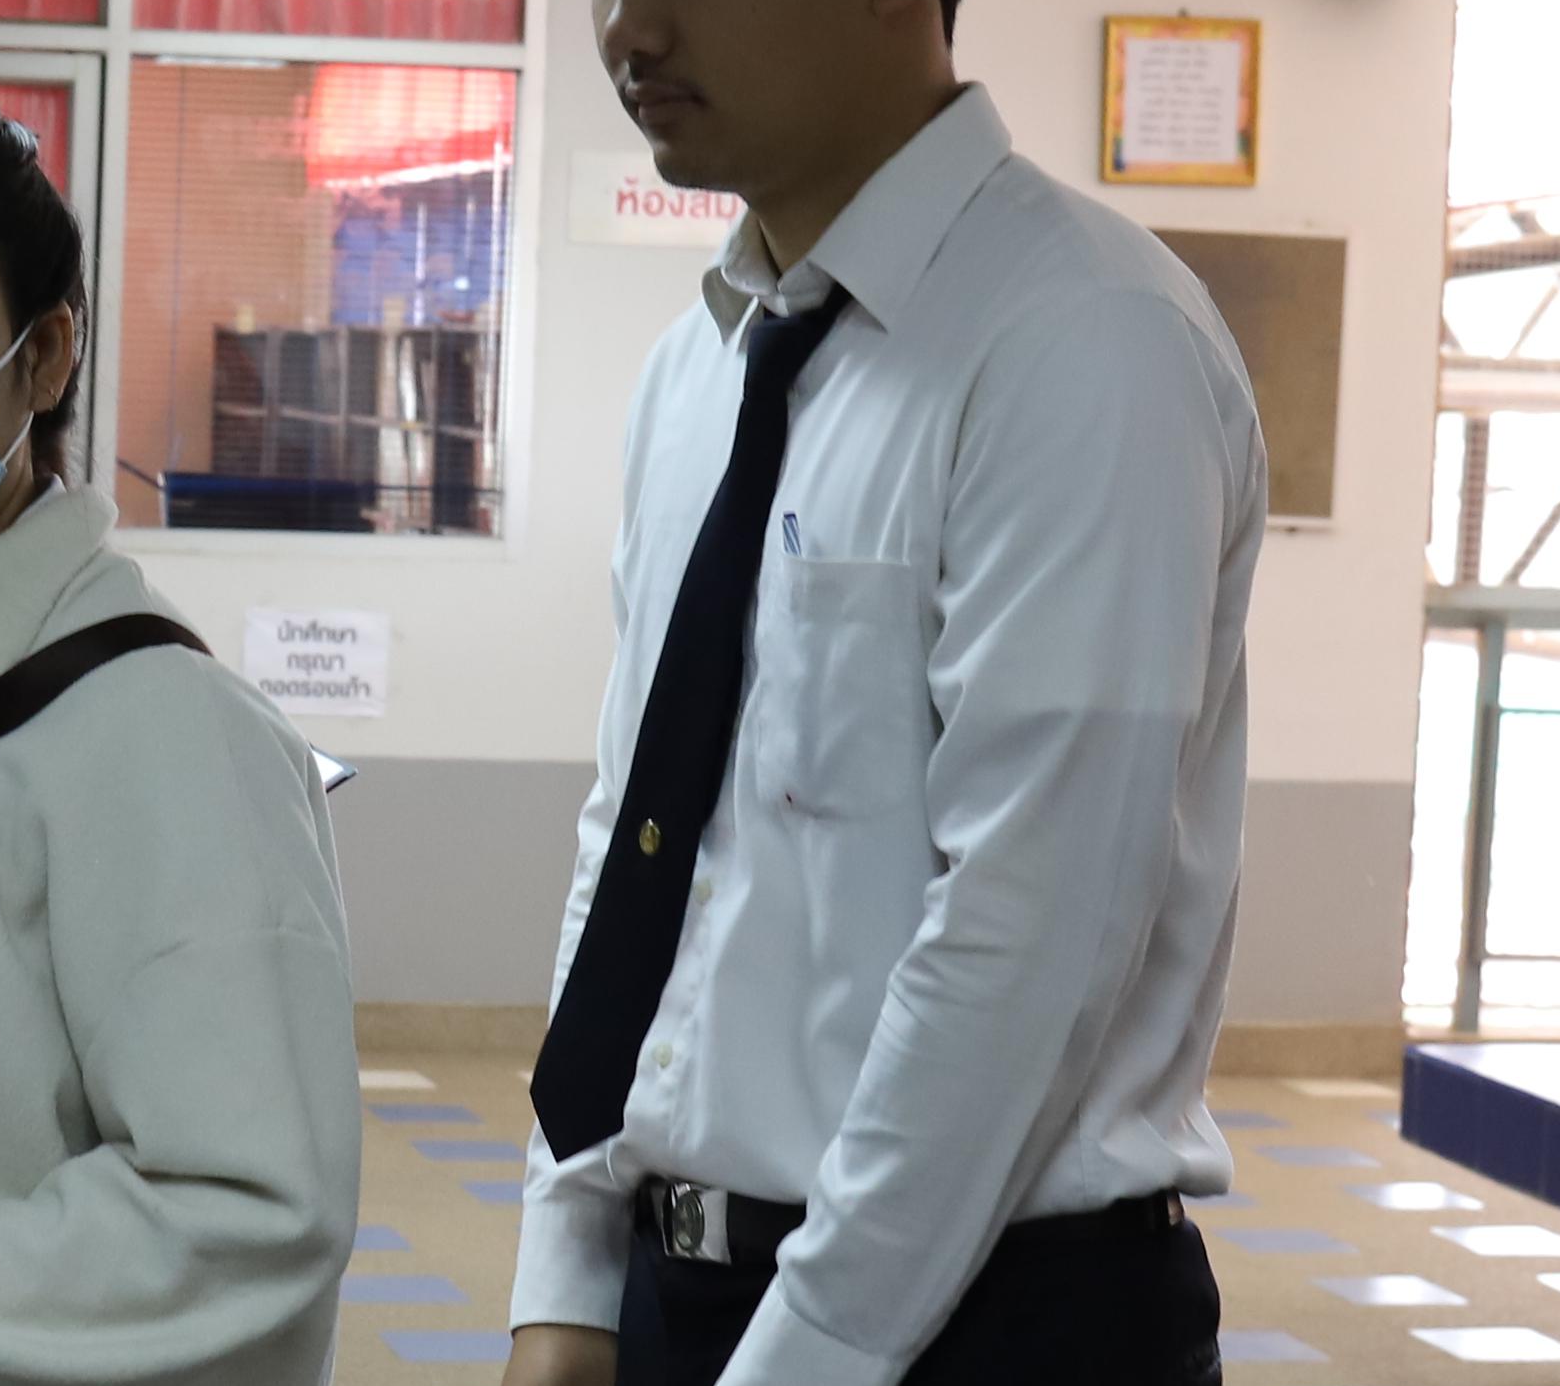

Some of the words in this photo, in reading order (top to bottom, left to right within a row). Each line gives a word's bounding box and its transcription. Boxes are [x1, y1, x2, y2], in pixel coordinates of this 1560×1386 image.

[616, 176, 740, 219] ห้องสม
[277, 619, 358, 643] นักศึกษา
[287, 652, 345, 676] กรุณา
